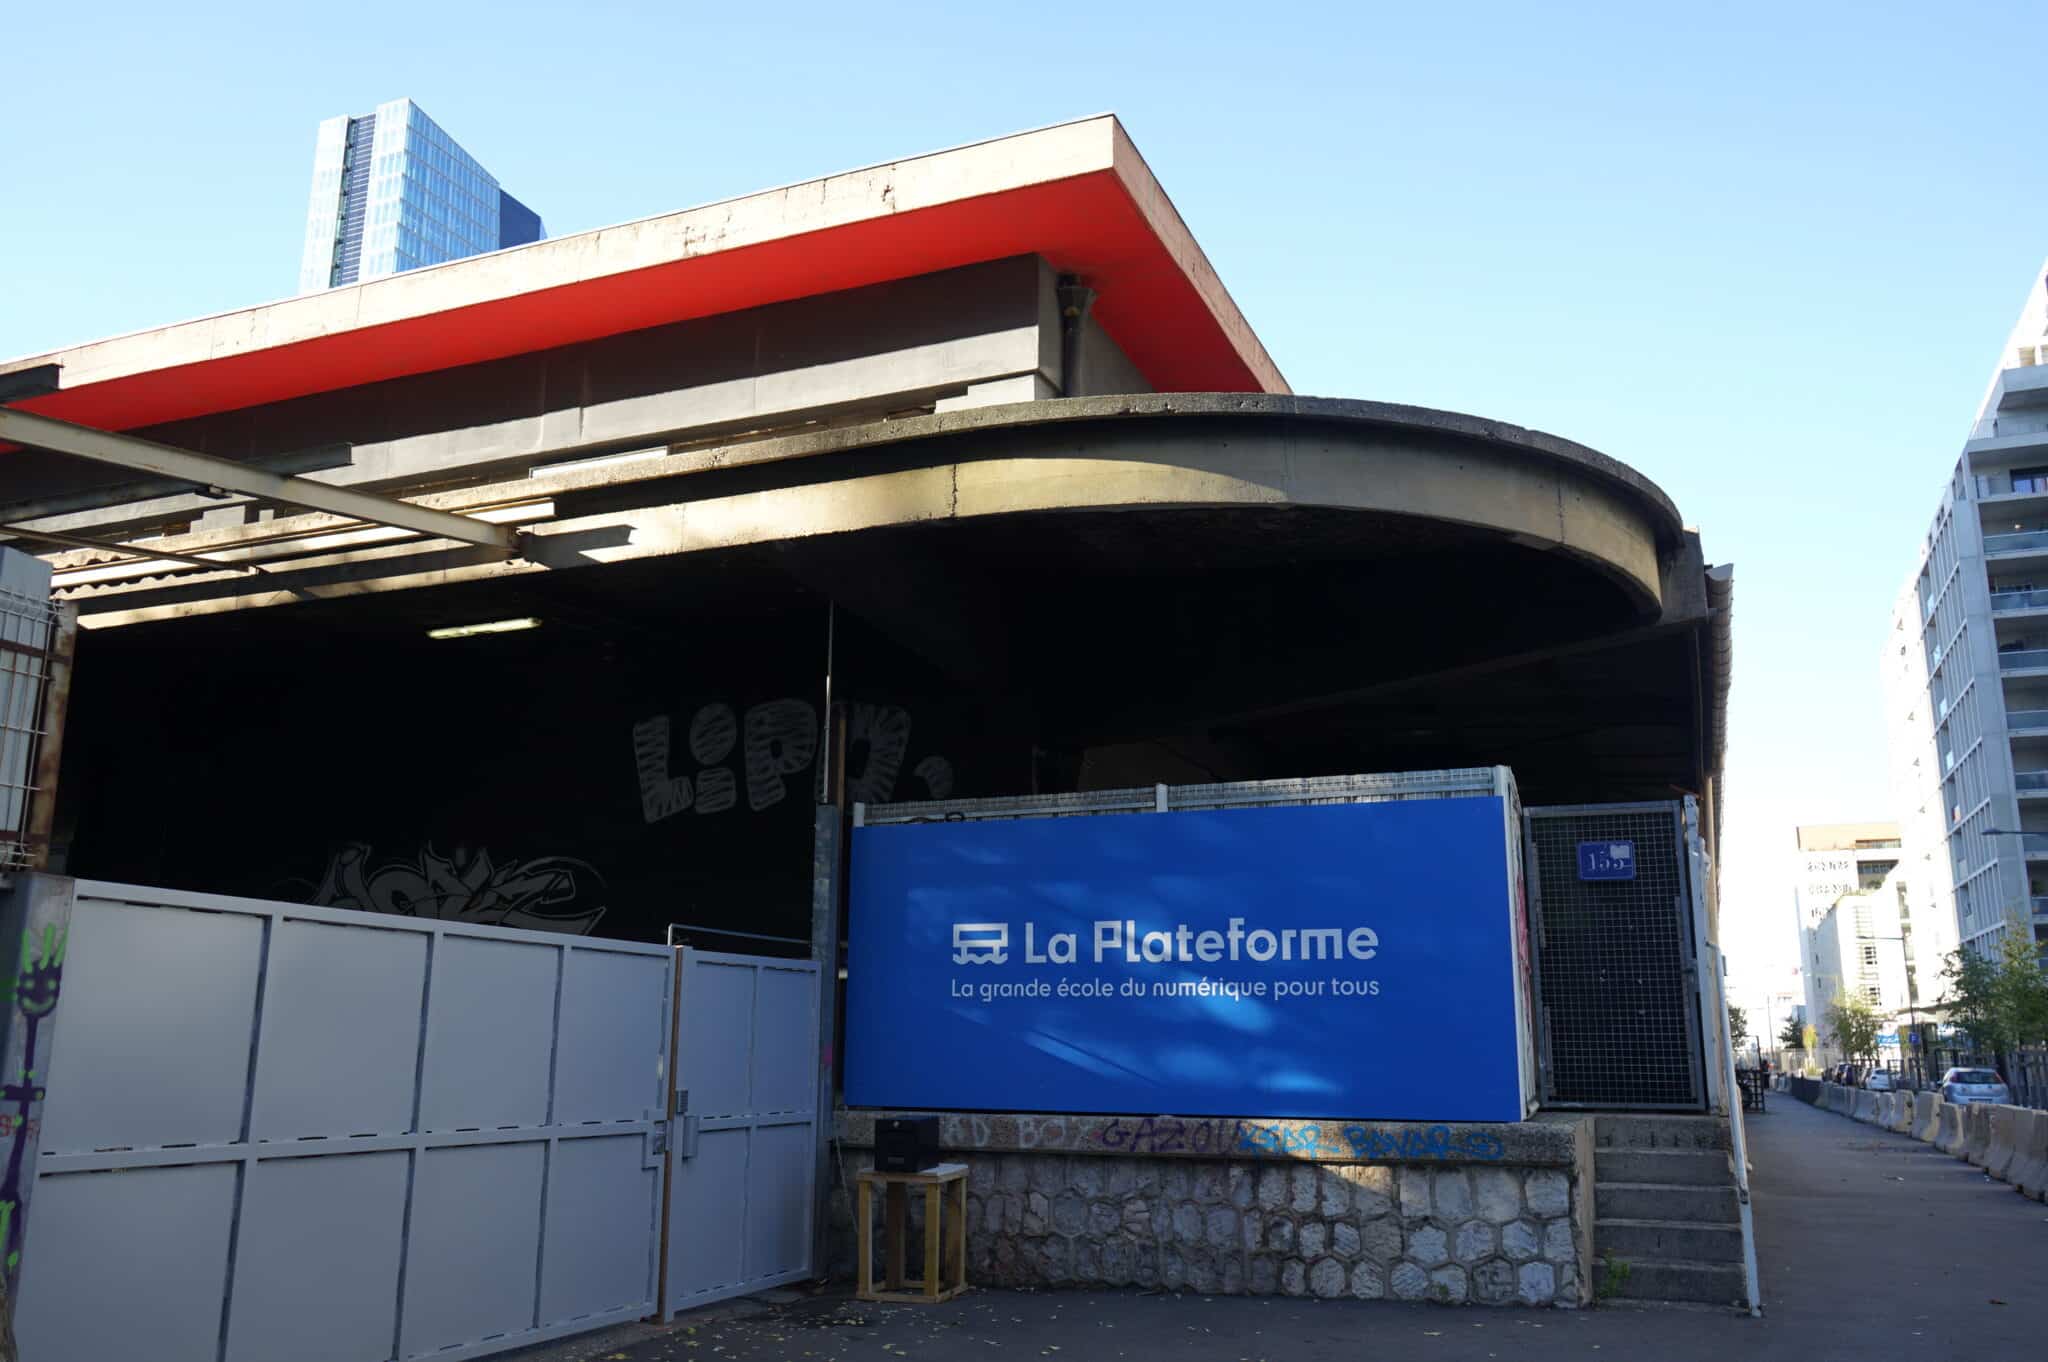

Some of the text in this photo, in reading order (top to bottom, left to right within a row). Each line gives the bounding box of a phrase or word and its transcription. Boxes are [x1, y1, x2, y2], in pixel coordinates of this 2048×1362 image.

[1025, 917, 1379, 964] La Plateforme
[951, 976, 1379, 1003] La grande école du numérique pour tous
